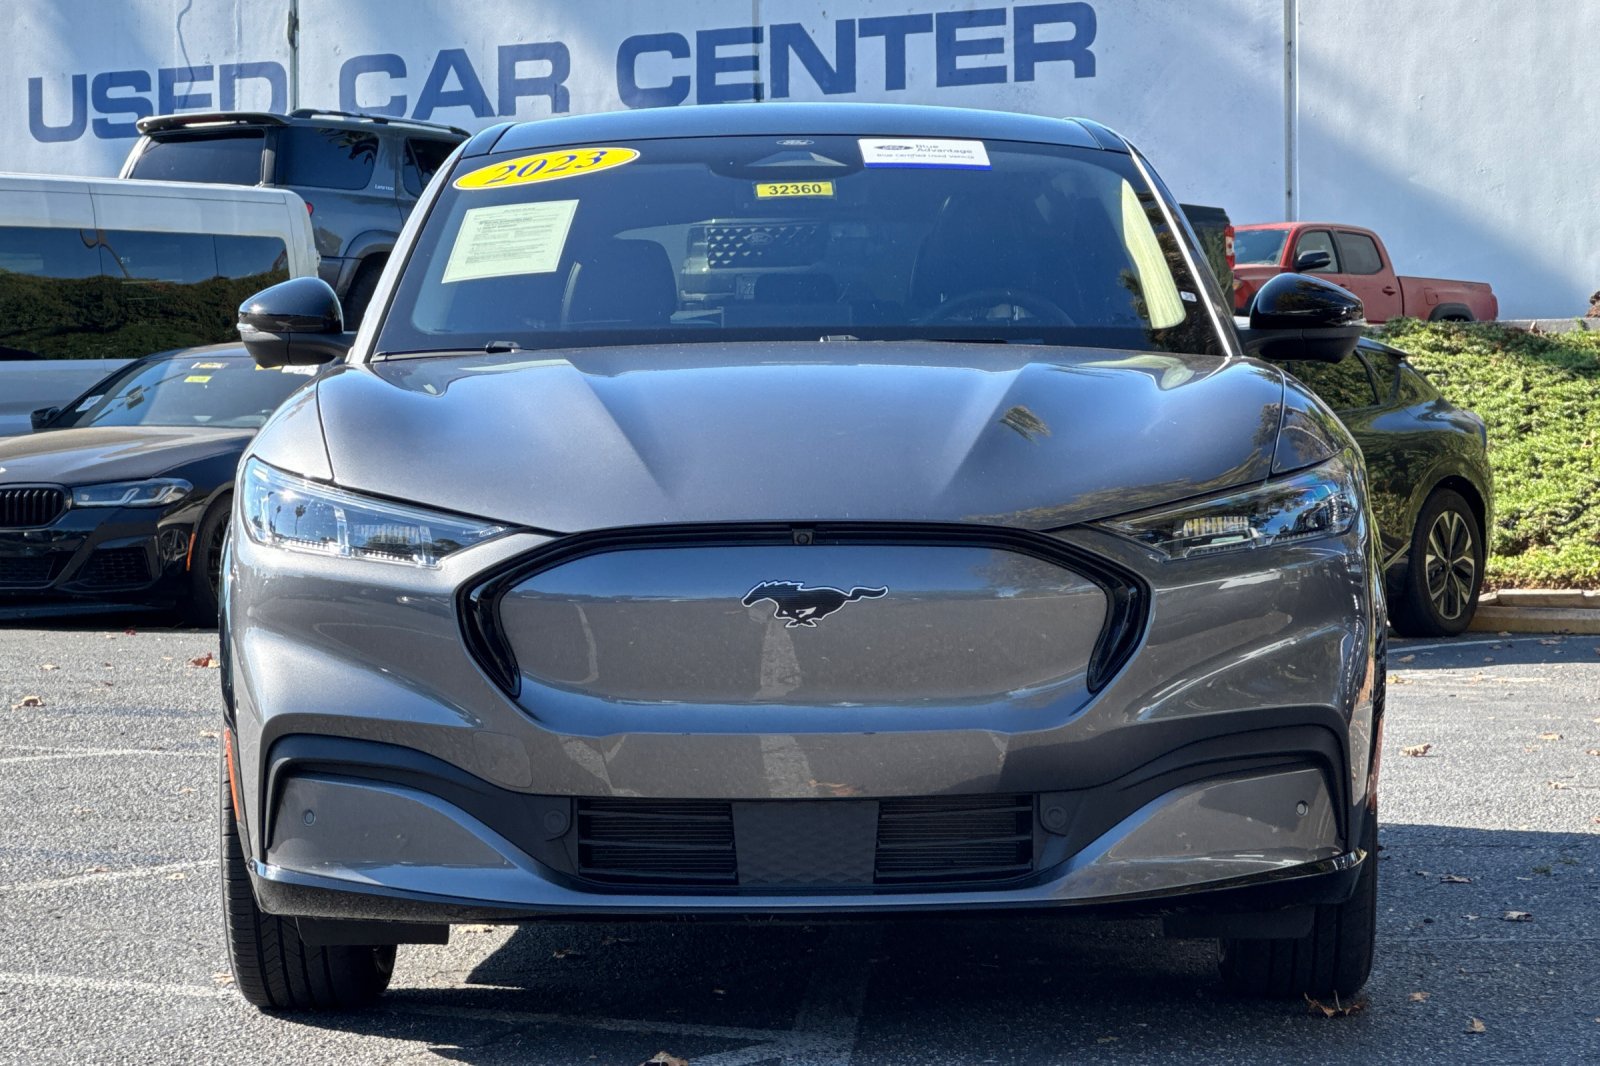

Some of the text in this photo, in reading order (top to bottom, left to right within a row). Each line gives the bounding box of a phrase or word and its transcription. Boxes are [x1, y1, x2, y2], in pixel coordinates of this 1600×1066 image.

[28, 2, 1097, 143] USED CAR CENTER
[484, 150, 609, 185] 2023
[768, 184, 822, 195] 32360
